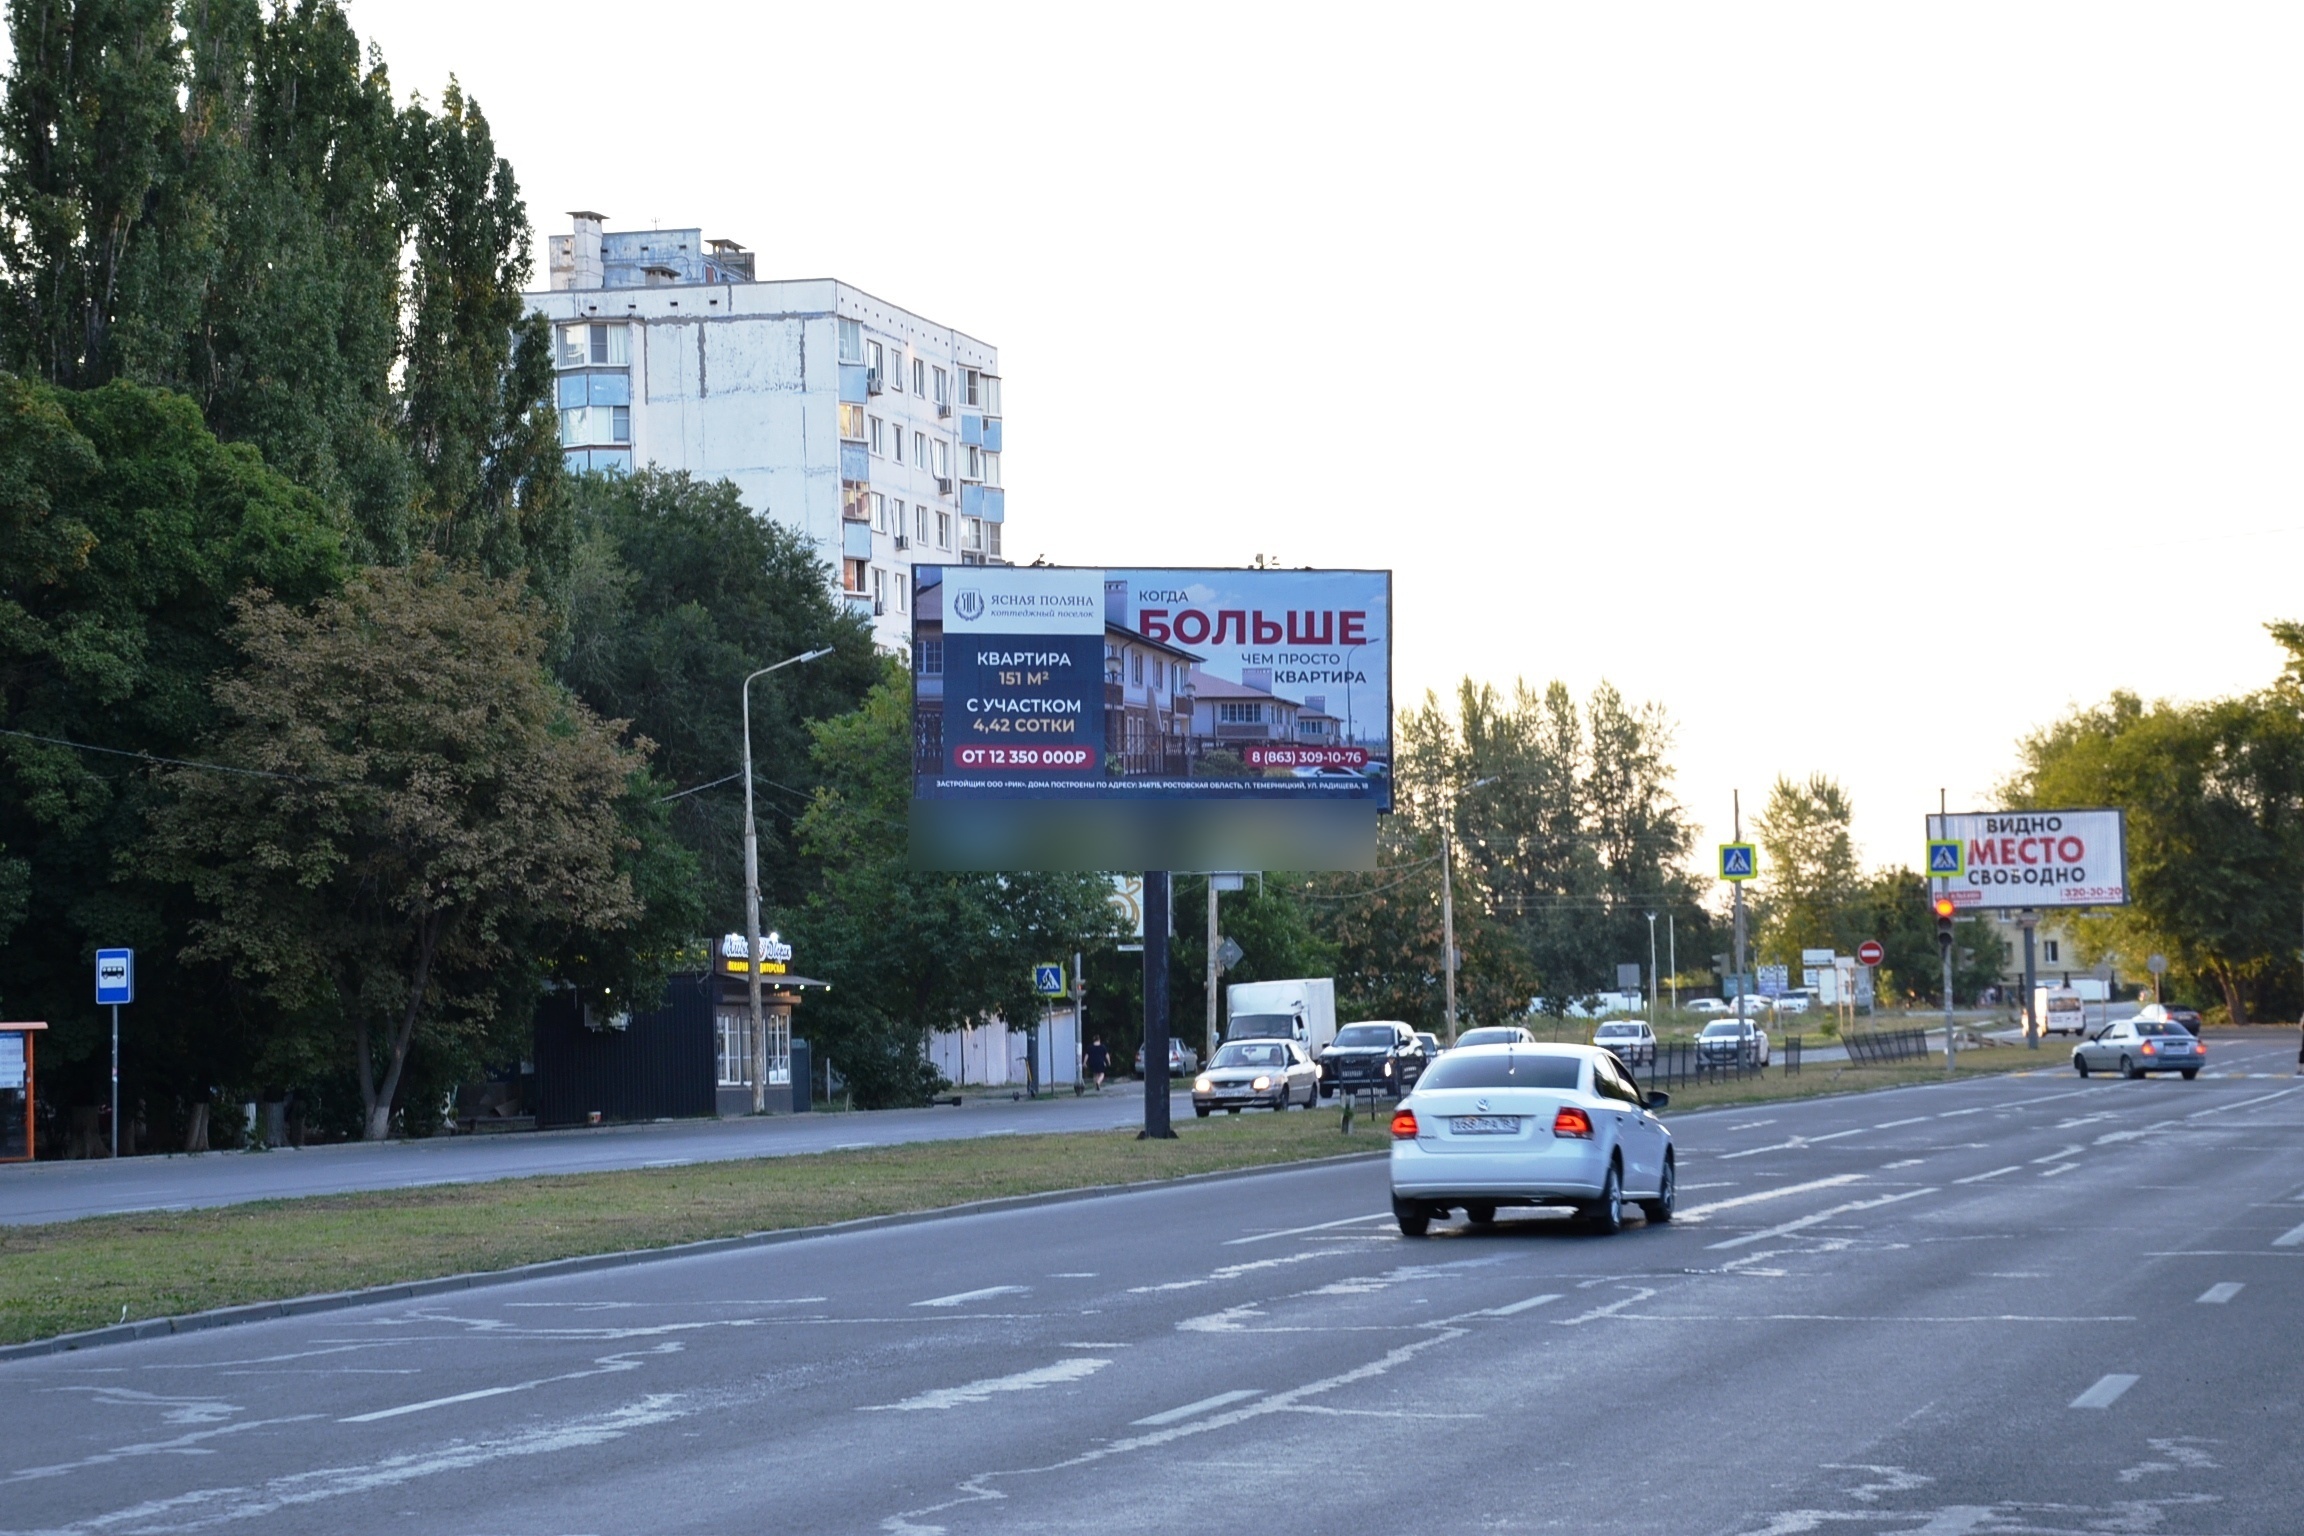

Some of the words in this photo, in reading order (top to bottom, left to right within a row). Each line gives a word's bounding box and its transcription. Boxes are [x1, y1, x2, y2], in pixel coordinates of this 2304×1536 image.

[991, 595, 1036, 606] ЯСНАЯ
[1040, 595, 1095, 607] ПОЛЯНА
[1140, 590, 1189, 603] КОГДА
[991, 609, 1055, 618] коттеджный
[1057, 610, 1095, 619] поселок
[1139, 609, 1368, 646] БОЛЬШЕ
[977, 651, 1072, 667] КВАРТИРА
[1241, 653, 1274, 665] ЧЕМ
[1279, 653, 1341, 665] ПРОСТО
[998, 671, 1022, 685] 151
[1274, 670, 1367, 684] КВАРТИРА
[966, 698, 978, 712] С
[983, 698, 1081, 713] УЧАСТКОМ
[973, 718, 1010, 734] 4,42
[1015, 719, 1075, 732] СОТКИ
[962, 750, 985, 763] ОТ
[989, 750, 1005, 763] 12
[1008, 750, 1038, 764] 350
[1252, 751, 1260, 763] 8
[1264, 751, 1296, 765] (863)
[1299, 751, 1361, 763] 309-10-76
[936, 779, 985, 789] ЗАСТРОЙЩИК
[986, 780, 1003, 788] ООО
[1027, 780, 1050, 789] ДОМА
[1051, 781, 1095, 789] ПОСТРОЕНЫ
[1096, 781, 1107, 789] ПО
[1162, 781, 1209, 789] РОСТОВСКАЯ
[1986, 817, 2063, 836] ВИДНО
[1967, 836, 2085, 866] МЕСТО
[1968, 867, 2086, 886] СВОБОДНО
